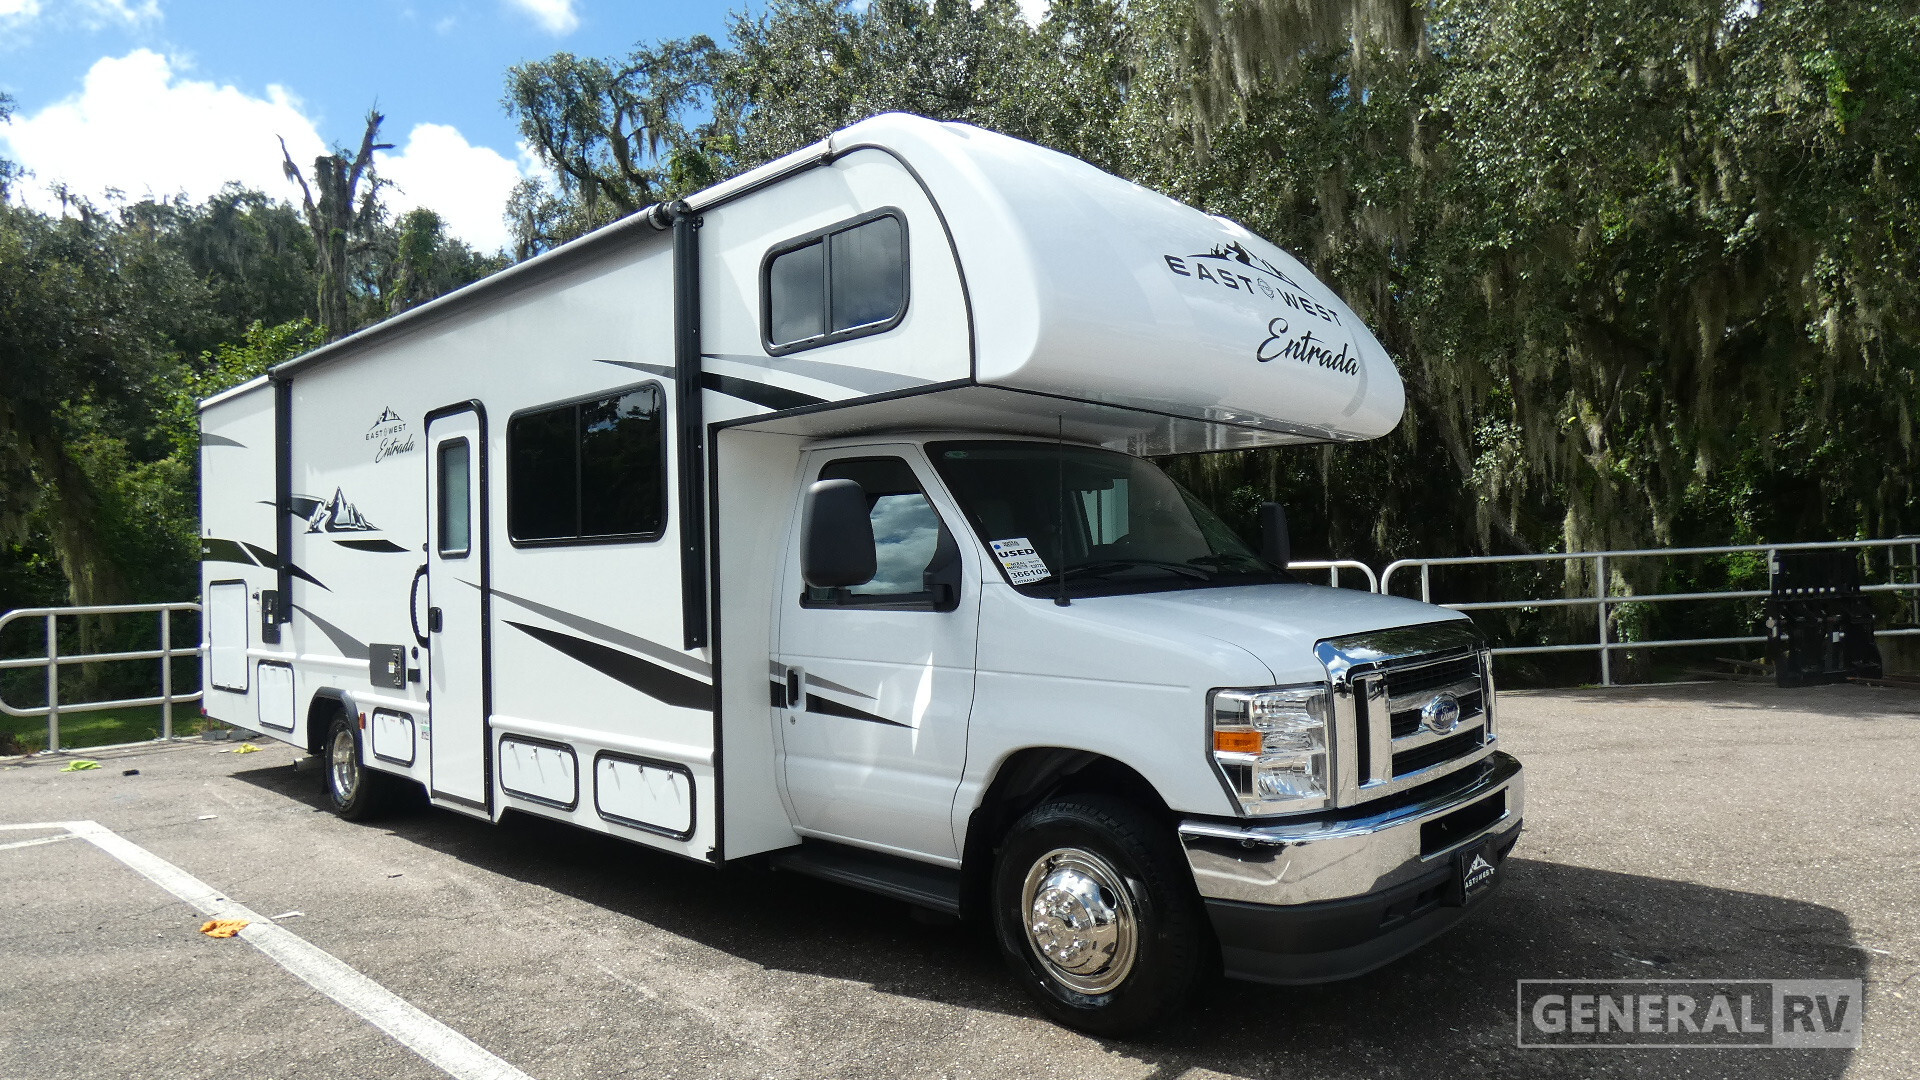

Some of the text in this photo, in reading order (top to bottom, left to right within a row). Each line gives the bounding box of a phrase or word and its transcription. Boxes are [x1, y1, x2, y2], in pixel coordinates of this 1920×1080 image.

[1164, 254, 1342, 327] EAST WEST
[1256, 317, 1360, 376] Entrada
[365, 423, 406, 441] EAST WEST
[375, 434, 415, 464] Entrada
[998, 548, 1035, 558] USED
[1011, 568, 1049, 579] 366109
